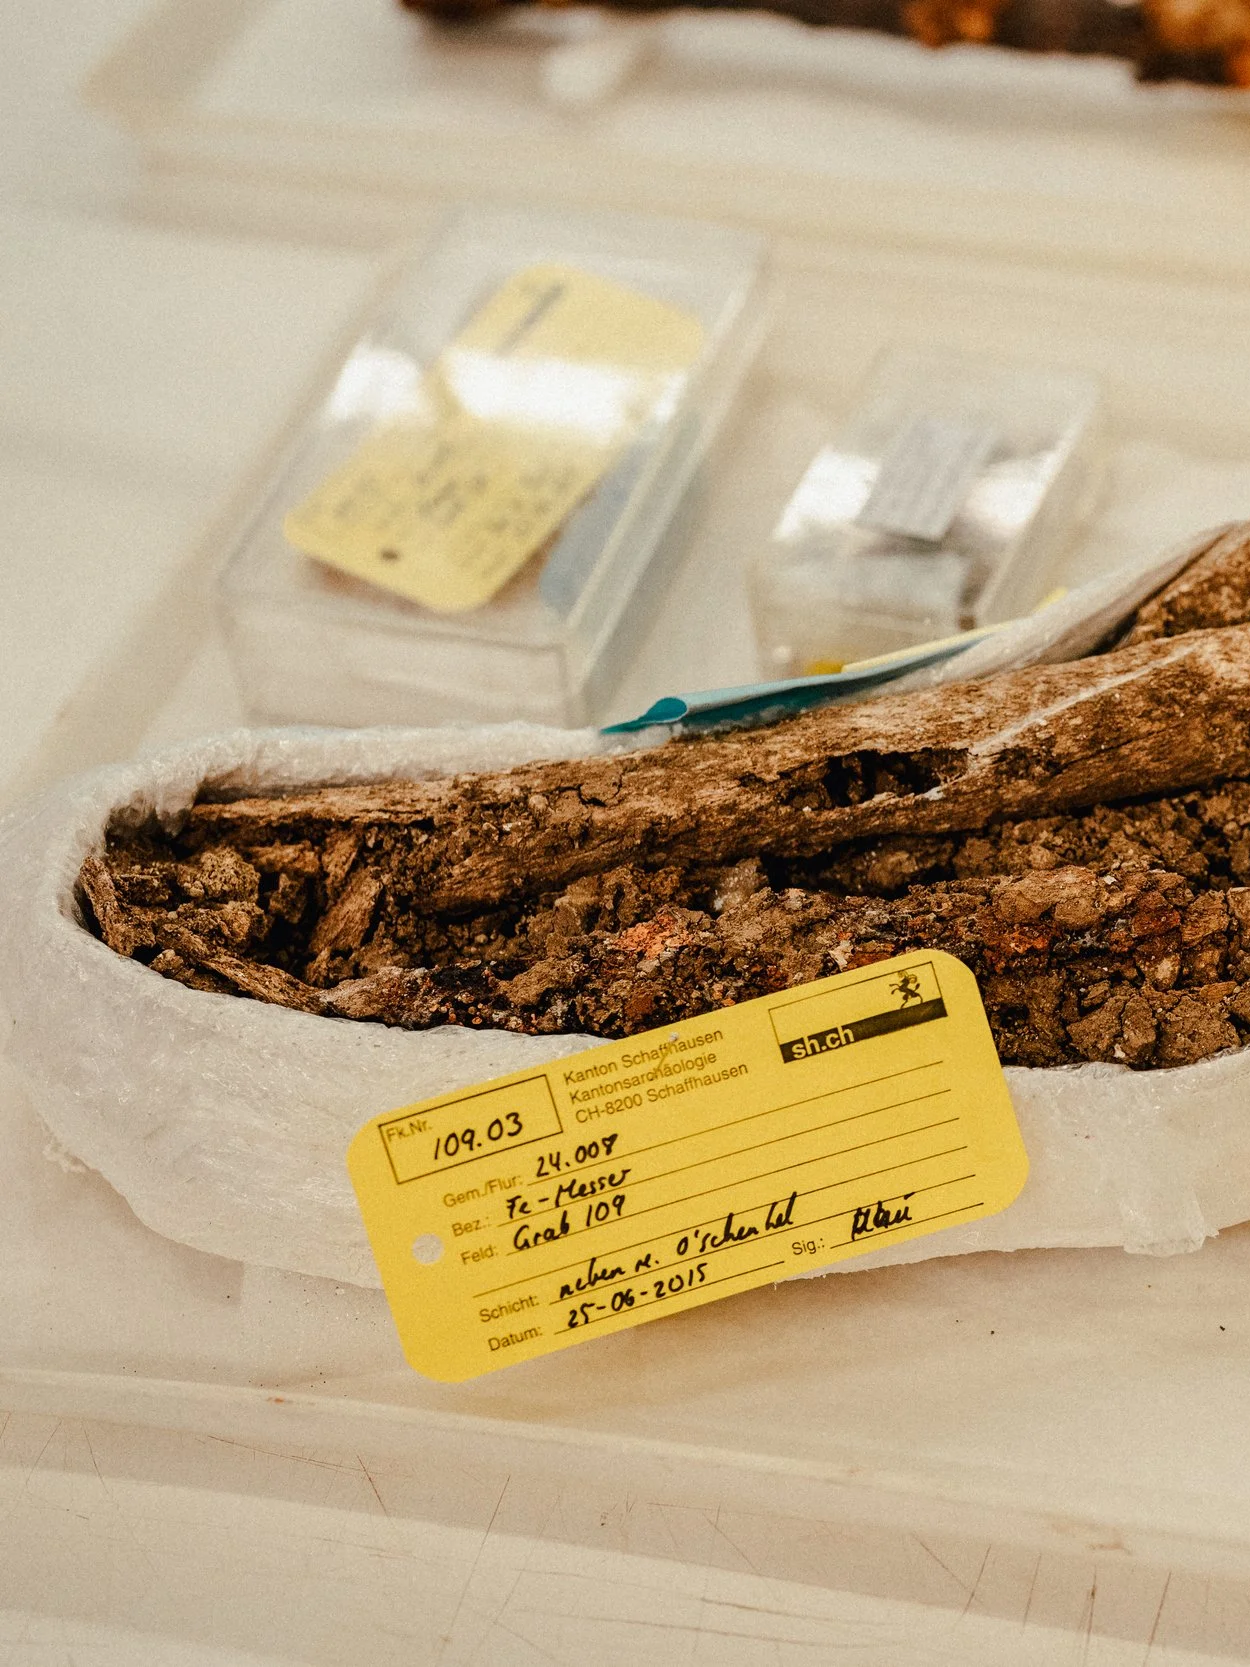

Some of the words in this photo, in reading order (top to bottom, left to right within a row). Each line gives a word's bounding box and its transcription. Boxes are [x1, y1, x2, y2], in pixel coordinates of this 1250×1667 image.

[563, 1062, 618, 1086] Kanton
[621, 1030, 723, 1068] Schaffhausen
[788, 1026, 857, 1058] sh.ch
[575, 1094, 642, 1123] CH-8200
[647, 1064, 748, 1102] Schaffhausen
[385, 1120, 432, 1145] Fk.Nr.
[433, 1112, 524, 1161] 109.03
[536, 1133, 623, 1178] 24.008
[443, 1175, 522, 1207] Gem./Flur:
[451, 1217, 490, 1237] Bez.:
[513, 1211, 575, 1251] Grab
[585, 1194, 632, 1228] 109
[460, 1244, 498, 1265] Feld:
[792, 1238, 825, 1255] Sig.:
[551, 1249, 628, 1301] neben
[479, 1295, 539, 1323] Schicht:
[567, 1262, 714, 1330] 25-06-2015
[487, 1327, 543, 1352] Datum:
